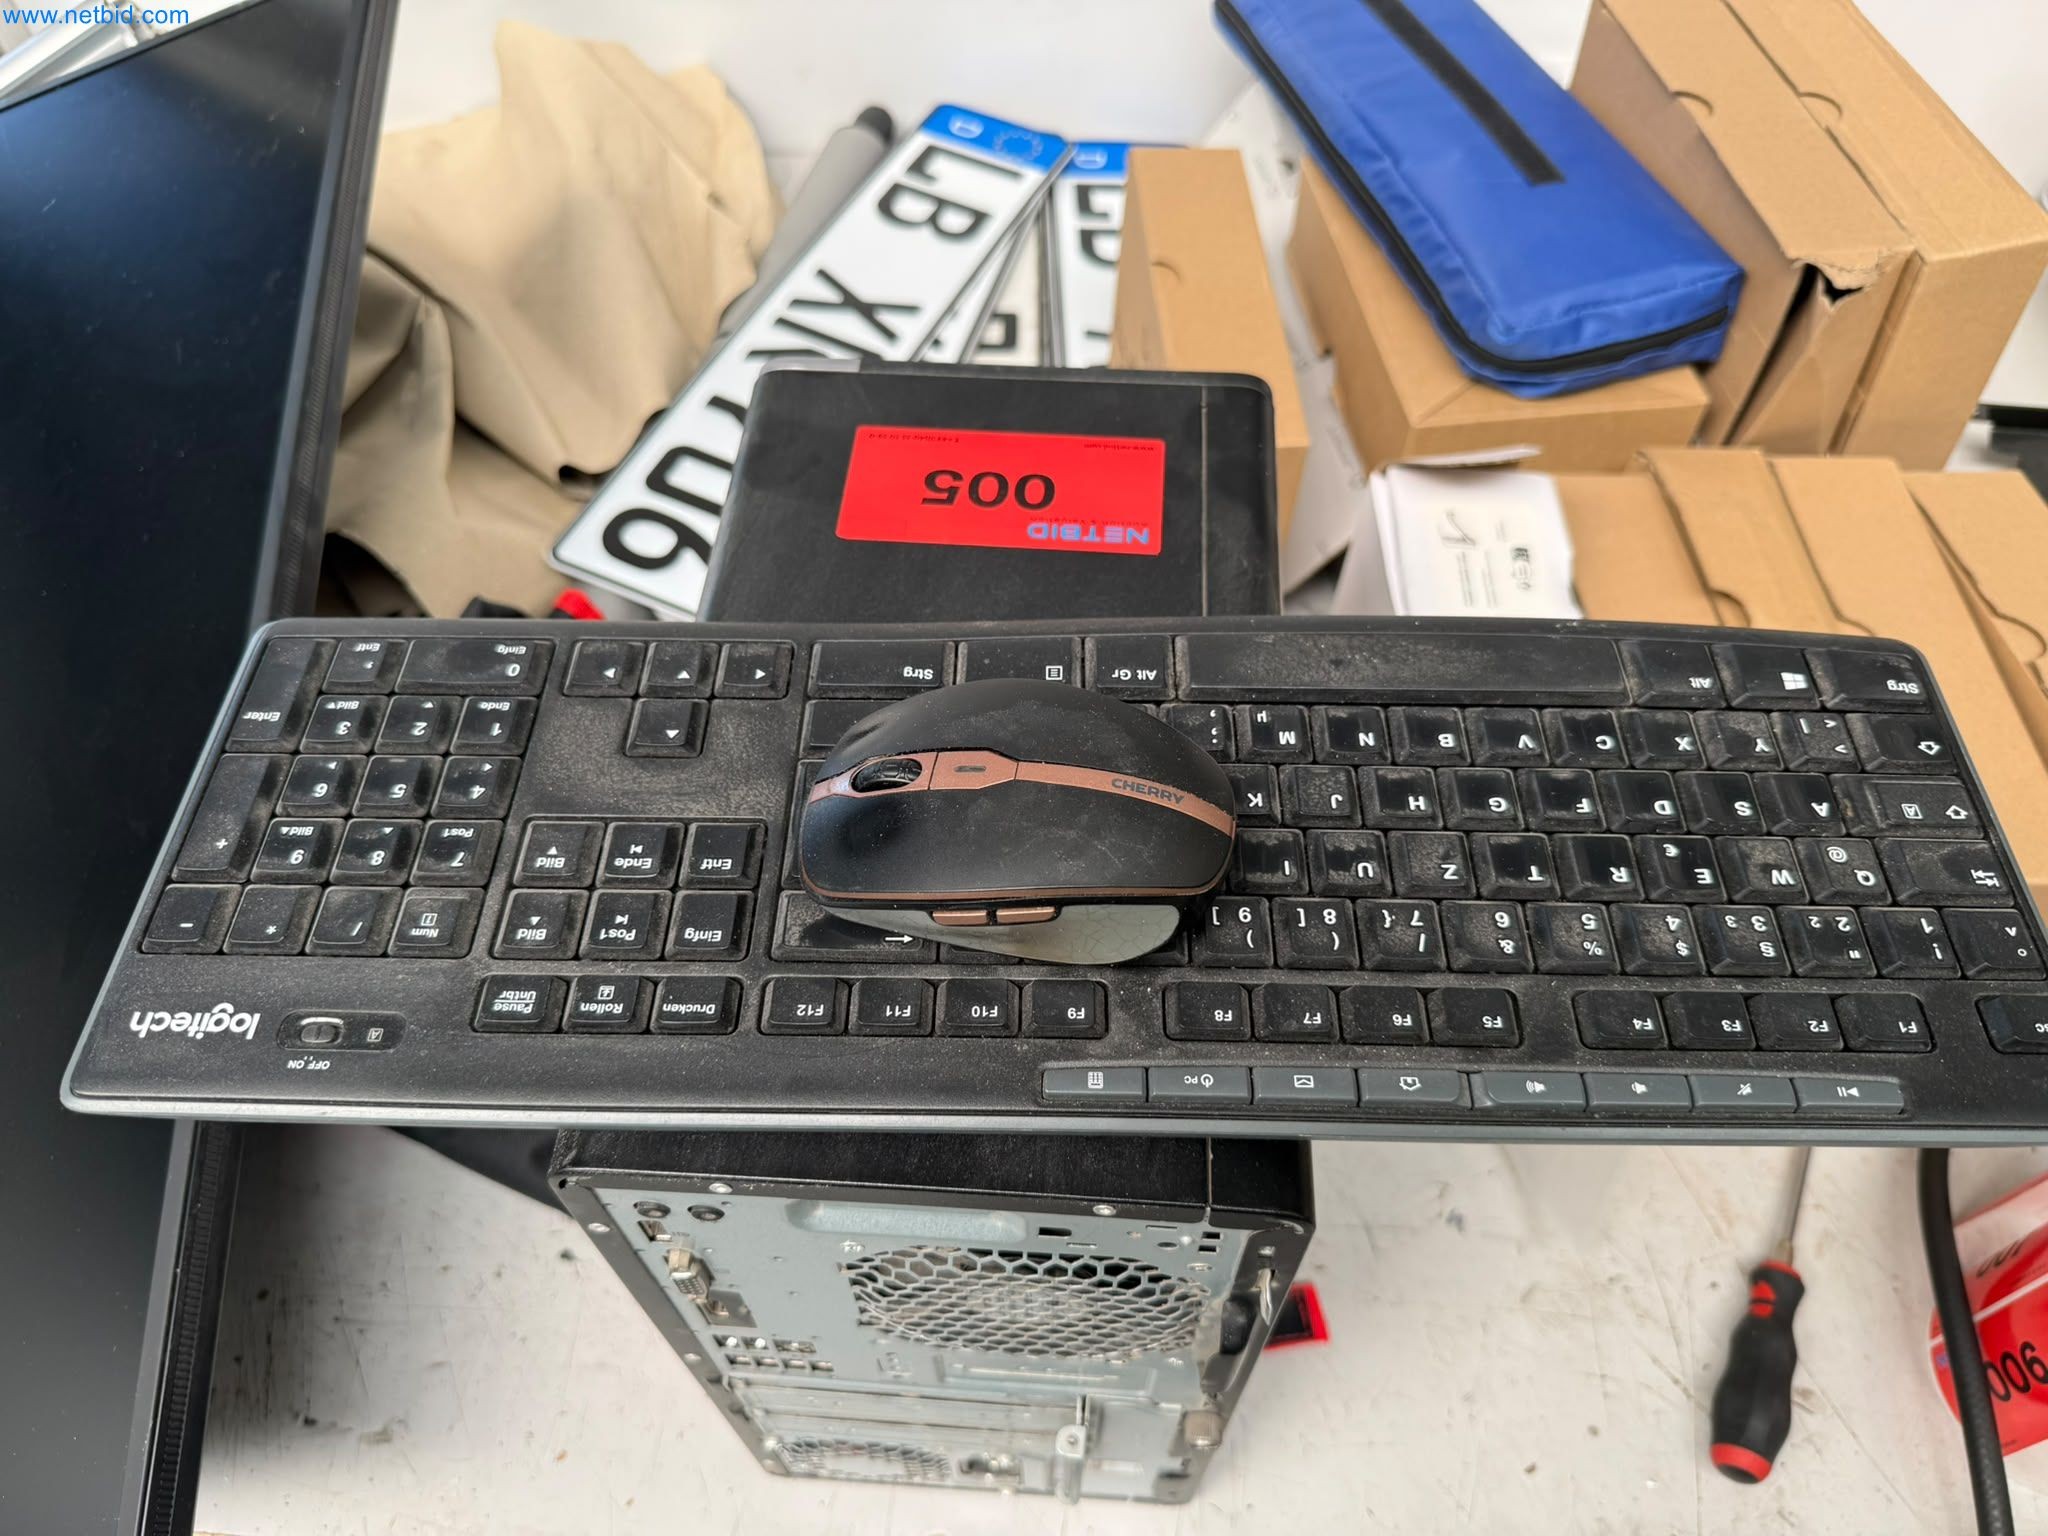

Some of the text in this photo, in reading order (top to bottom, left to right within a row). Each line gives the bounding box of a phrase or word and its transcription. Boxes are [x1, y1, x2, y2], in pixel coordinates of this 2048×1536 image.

[877, 145, 1023, 237] LB
[920, 469, 1056, 511] 005
[1027, 522, 1150, 545] NETBID
[355, 643, 380, 651] Entf
[497, 645, 526, 654] Einfg
[507, 664, 520, 676] 0
[904, 667, 933, 679] Strg
[1112, 669, 1156, 680] Alt Gr
[1689, 678, 1711, 688] Alt
[1887, 680, 1919, 693] Strg
[336, 700, 360, 711] Bild
[480, 702, 510, 710] Ende
[243, 712, 280, 721] Enter
[337, 722, 351, 734] 3
[413, 722, 427, 735] 2
[492, 723, 501, 736] 1
[1279, 731, 1295, 744] M
[1359, 733, 1374, 746] N
[1439, 734, 1454, 747] B
[1519, 735, 1535, 748] V
[1596, 736, 1613, 749] C
[1675, 737, 1692, 750] X
[1756, 739, 1770, 751] Y
[314, 784, 327, 797] 6
[392, 784, 406, 798] 5
[471, 785, 485, 799] 4
[1112, 778, 1186, 806] CHERRY
[1248, 793, 1262, 807] K
[1331, 795, 1342, 808] J
[1409, 796, 1425, 810] H
[1489, 798, 1507, 811] G
[1577, 799, 1590, 812] F
[1654, 801, 1672, 814] D
[1735, 802, 1752, 816] S
[1811, 803, 1828, 817] A
[290, 826, 314, 837] Bild
[443, 828, 473, 837] Pos1
[1663, 844, 1678, 856] €
[1827, 847, 1847, 862] @
[290, 850, 304, 864] 9
[371, 851, 384, 865] 8
[451, 852, 464, 866] 7
[536, 857, 565, 868] Bild
[615, 858, 652, 868] Ende
[700, 859, 732, 869] Entf
[1285, 861, 1289, 875] I
[1358, 863, 1373, 877] U
[1441, 865, 1458, 879] Z
[1528, 866, 1544, 880] T
[1610, 867, 1628, 882] R
[1694, 869, 1712, 884] E
[1772, 870, 1794, 884] W
[1854, 870, 1875, 885] Q
[1213, 907, 1220, 925] ]
[1239, 907, 1251, 922] 9
[1297, 908, 1305, 927] [
[1323, 909, 1336, 924] 8
[1411, 911, 1423, 925] 7
[1495, 912, 1509, 927] 6
[1582, 914, 1595, 929] 5
[1666, 916, 1680, 930] 4
[1836, 917, 1850, 931] 2
[1921, 918, 1933, 933] 1
[411, 929, 438, 937] Num
[517, 929, 547, 940] Bild
[600, 929, 636, 940] Pos1
[685, 928, 722, 941] Einfg
[1247, 930, 1253, 948] )
[1332, 932, 1339, 950] (
[1499, 940, 1514, 953] &
[1584, 942, 1602, 955] %
[1676, 940, 1688, 956] $
[1933, 944, 1942, 959] !
[500, 989, 537, 1000] Untbr
[493, 1003, 534, 1014] Pause
[581, 1003, 623, 1013] Rollen
[663, 1004, 715, 1014] Drucken
[797, 1005, 823, 1016] F12
[886, 1005, 910, 1016] F11
[972, 1006, 997, 1017] F10
[1068, 1008, 1084, 1019] F9
[130, 1003, 260, 1039] logitech
[1215, 1010, 1232, 1021] F8
[1304, 1013, 1321, 1024] F7
[1393, 1014, 1411, 1025] F6
[1483, 1016, 1502, 1027] F5
[1633, 1018, 1653, 1029] F4
[1722, 1020, 1741, 1031] F3
[1808, 1021, 1828, 1032] F2
[1899, 1022, 1917, 1033] F1
[287, 1058, 331, 1070] OFF ON
[1984, 1341, 2048, 1402] 006
